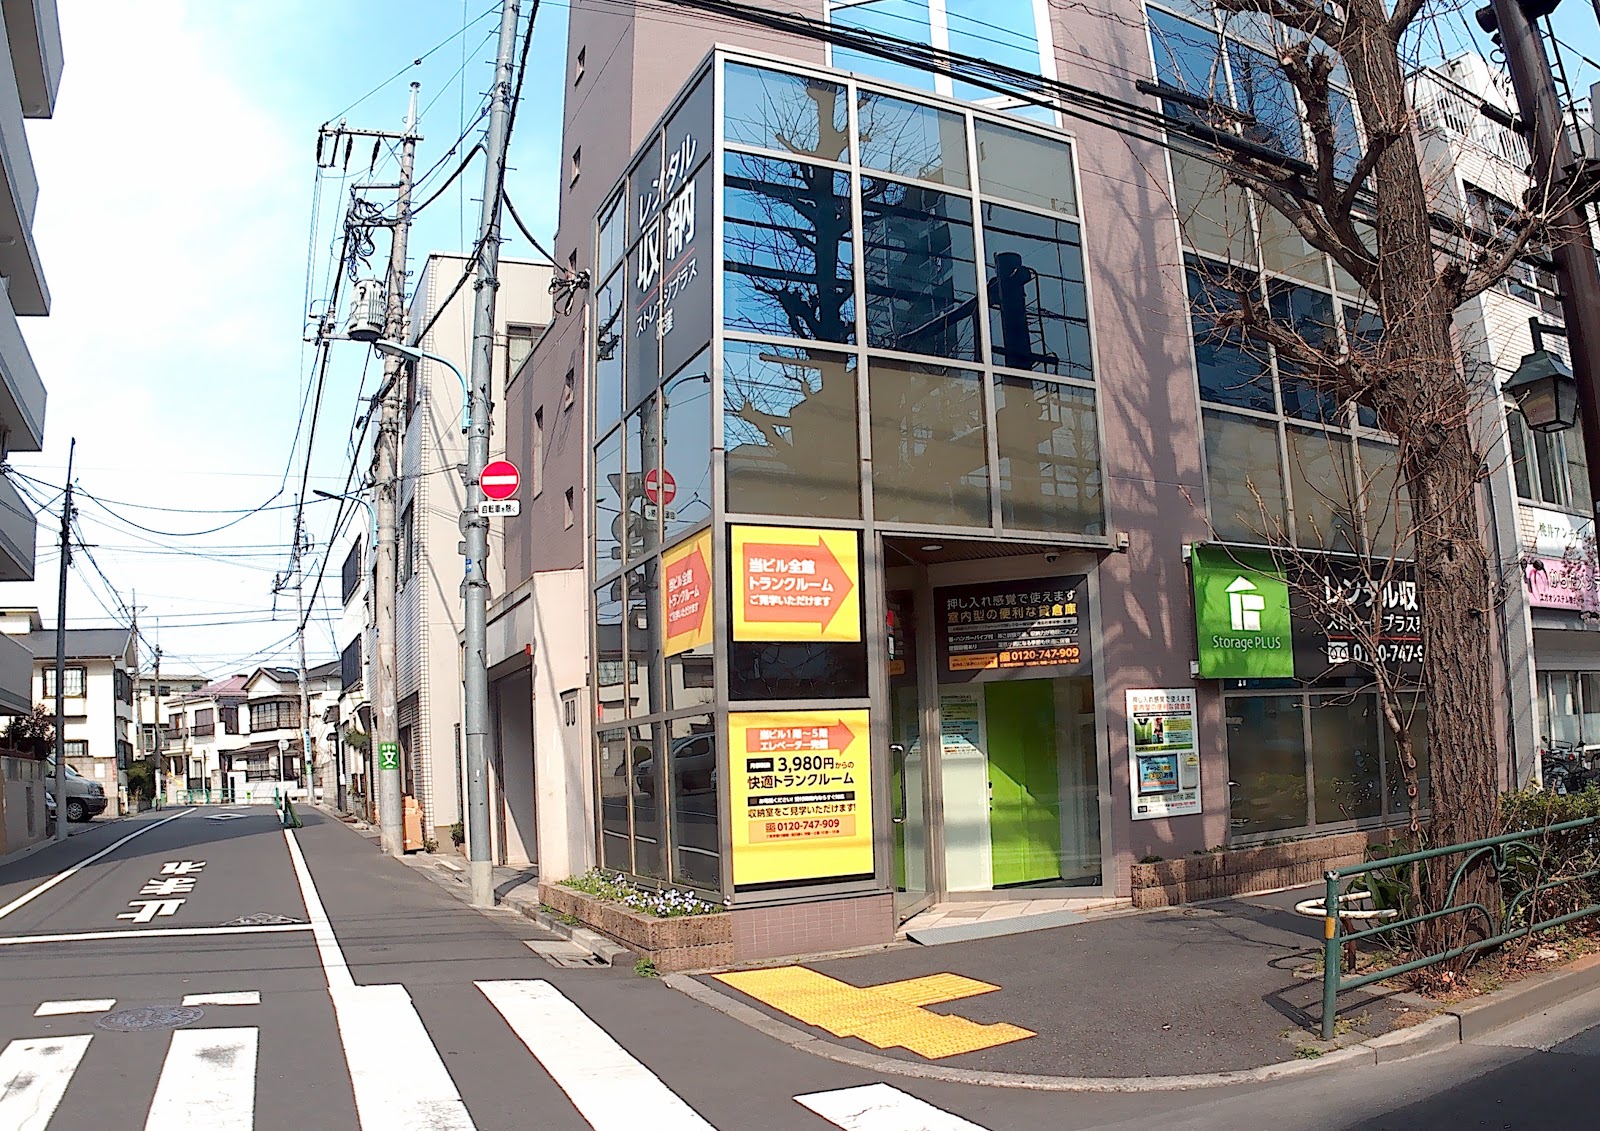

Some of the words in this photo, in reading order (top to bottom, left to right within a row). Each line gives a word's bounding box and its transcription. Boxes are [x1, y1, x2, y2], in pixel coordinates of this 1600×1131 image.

[638, 133, 697, 229] レンタル
[636, 178, 695, 293] 収納
[481, 504, 516, 514] 自転車を除く
[749, 558, 815, 575] 当ビル全館
[749, 576, 834, 592] トランクルーム
[669, 584, 700, 609] トランクルーム
[749, 594, 831, 607] ご見学いただけます
[947, 590, 1076, 610] 押し入れ感覚で使えます
[947, 602, 1077, 624] 室内型の便利な貸倉庫
[1213, 635, 1253, 651] Storage
[1254, 636, 1281, 649] PLUS
[1011, 647, 1080, 661] 0120-747-909
[382, 750, 397, 766] 文
[747, 772, 855, 790] 快適トランクルーム
[747, 803, 857, 818] 収納室をご見学いただけます!
[777, 818, 840, 832] 0120-747-909
[116, 861, 207, 923] 止まれ
